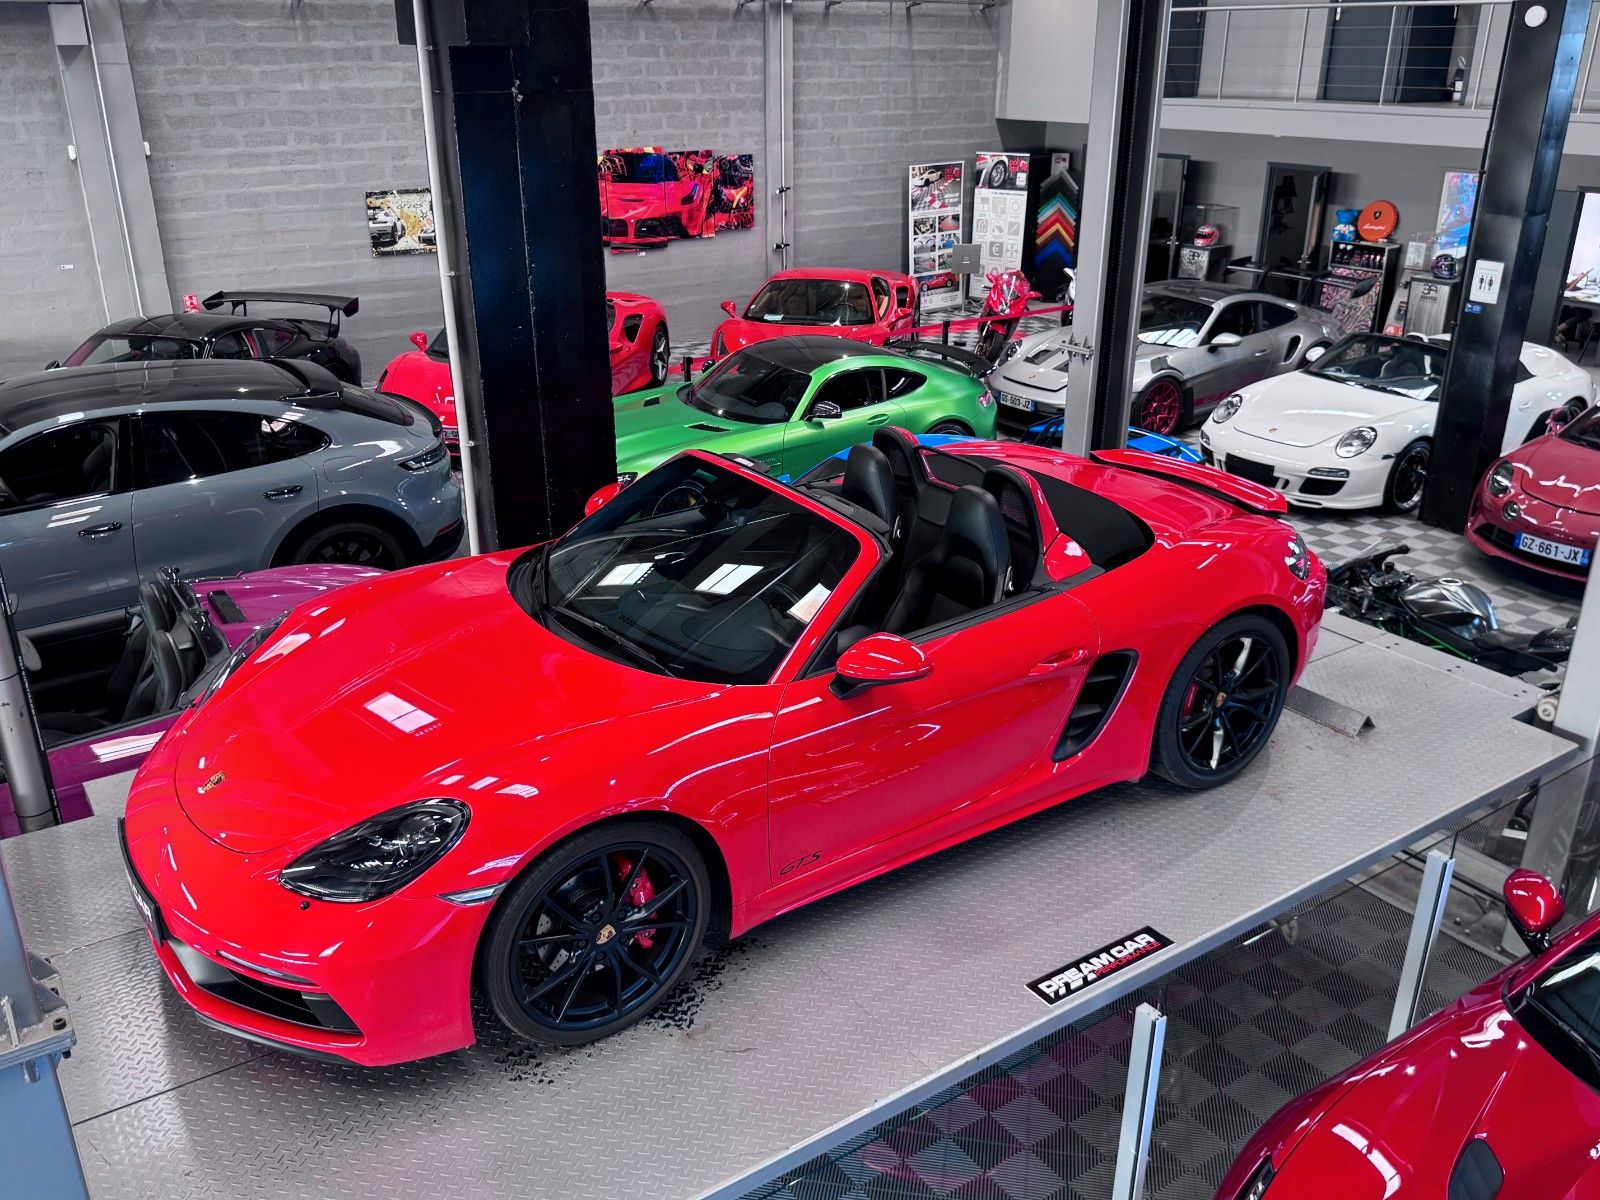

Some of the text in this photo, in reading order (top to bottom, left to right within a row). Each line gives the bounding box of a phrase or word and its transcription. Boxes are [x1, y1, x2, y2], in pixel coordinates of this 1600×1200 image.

[1521, 536, 1580, 562] GZ-661-JX
[779, 849, 823, 876] GTS
[1037, 933, 1156, 996] DREAM CAR
[1094, 941, 1162, 977] PERFORMANCE
